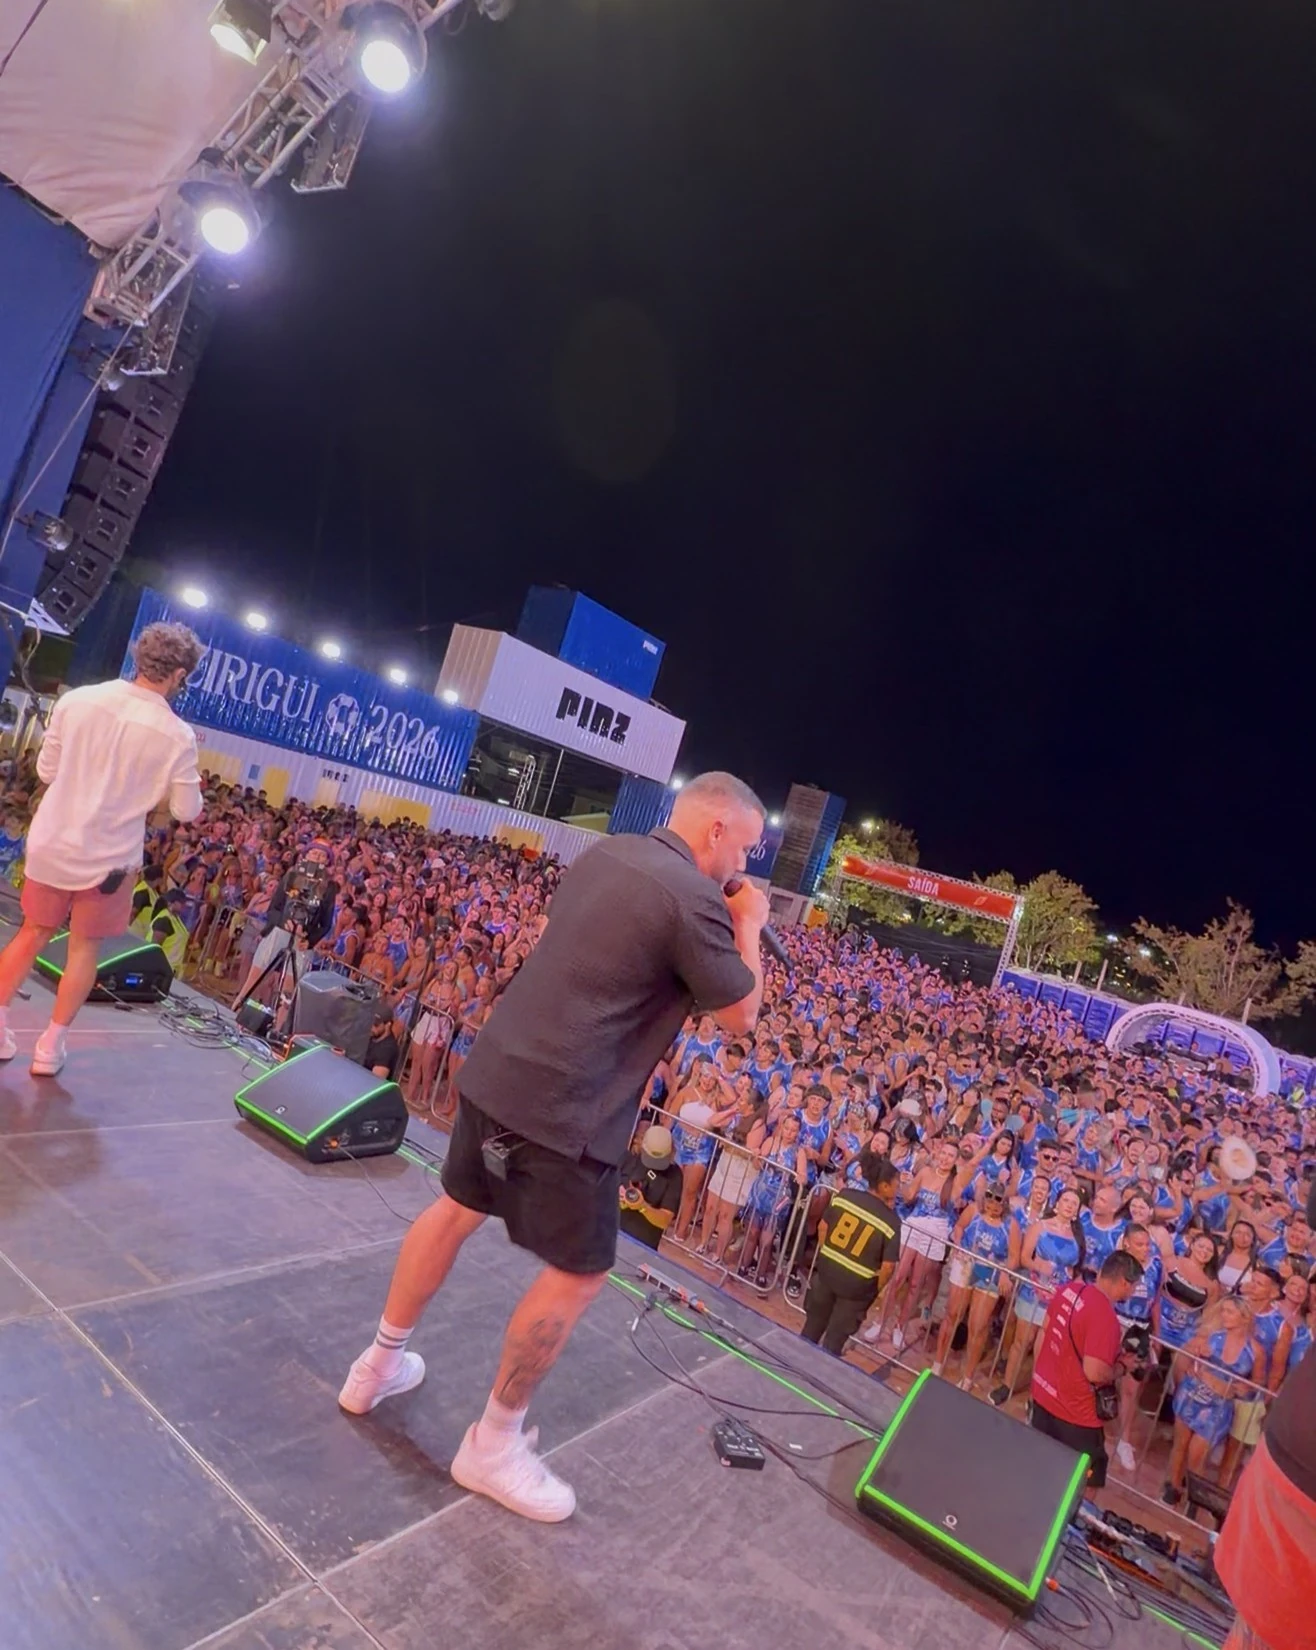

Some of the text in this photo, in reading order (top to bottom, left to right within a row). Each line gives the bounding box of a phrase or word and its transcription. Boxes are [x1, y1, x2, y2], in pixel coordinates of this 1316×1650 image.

[365, 705, 441, 759] 2026
[907, 876, 939, 897] SAÍDA
[830, 1211, 876, 1258] 81
